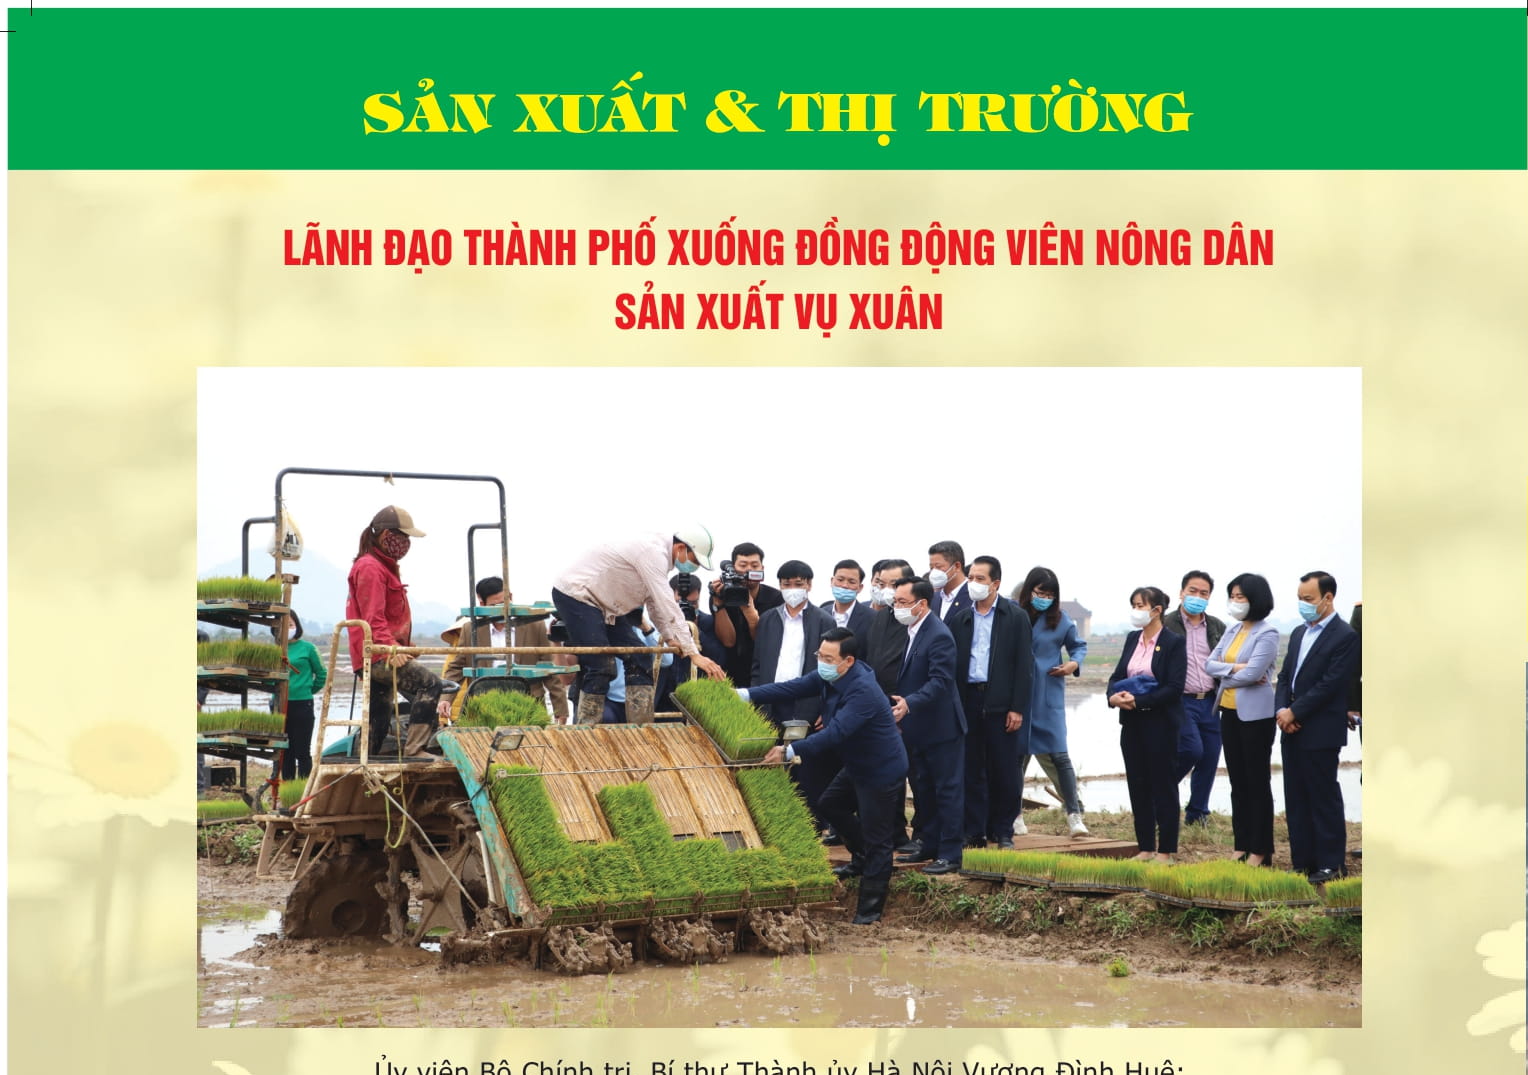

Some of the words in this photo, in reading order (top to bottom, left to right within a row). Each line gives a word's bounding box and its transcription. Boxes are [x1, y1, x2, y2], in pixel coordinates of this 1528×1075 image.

[364, 78, 495, 134] SẢN
[515, 72, 686, 133] XUẤT
[706, 90, 764, 133] &
[778, 92, 896, 146] THỊ
[919, 79, 1192, 133] TRƯỜNG
[285, 222, 371, 265] LÃNH
[384, 230, 451, 274] ĐẠO
[464, 222, 575, 265] THÀNH
[589, 216, 655, 265] PHỐ
[668, 216, 783, 265] XUỐNG
[796, 217, 888, 265] ĐỒNG
[901, 222, 994, 274] ĐỘNG
[1007, 222, 1083, 265] VIÊN
[1097, 222, 1190, 265] NÔNG
[1204, 222, 1272, 265] DÂN
[616, 281, 684, 329] SẢN
[697, 280, 784, 329] XUẤT
[795, 294, 836, 338] VỤ
[850, 286, 942, 329] XUÂN
